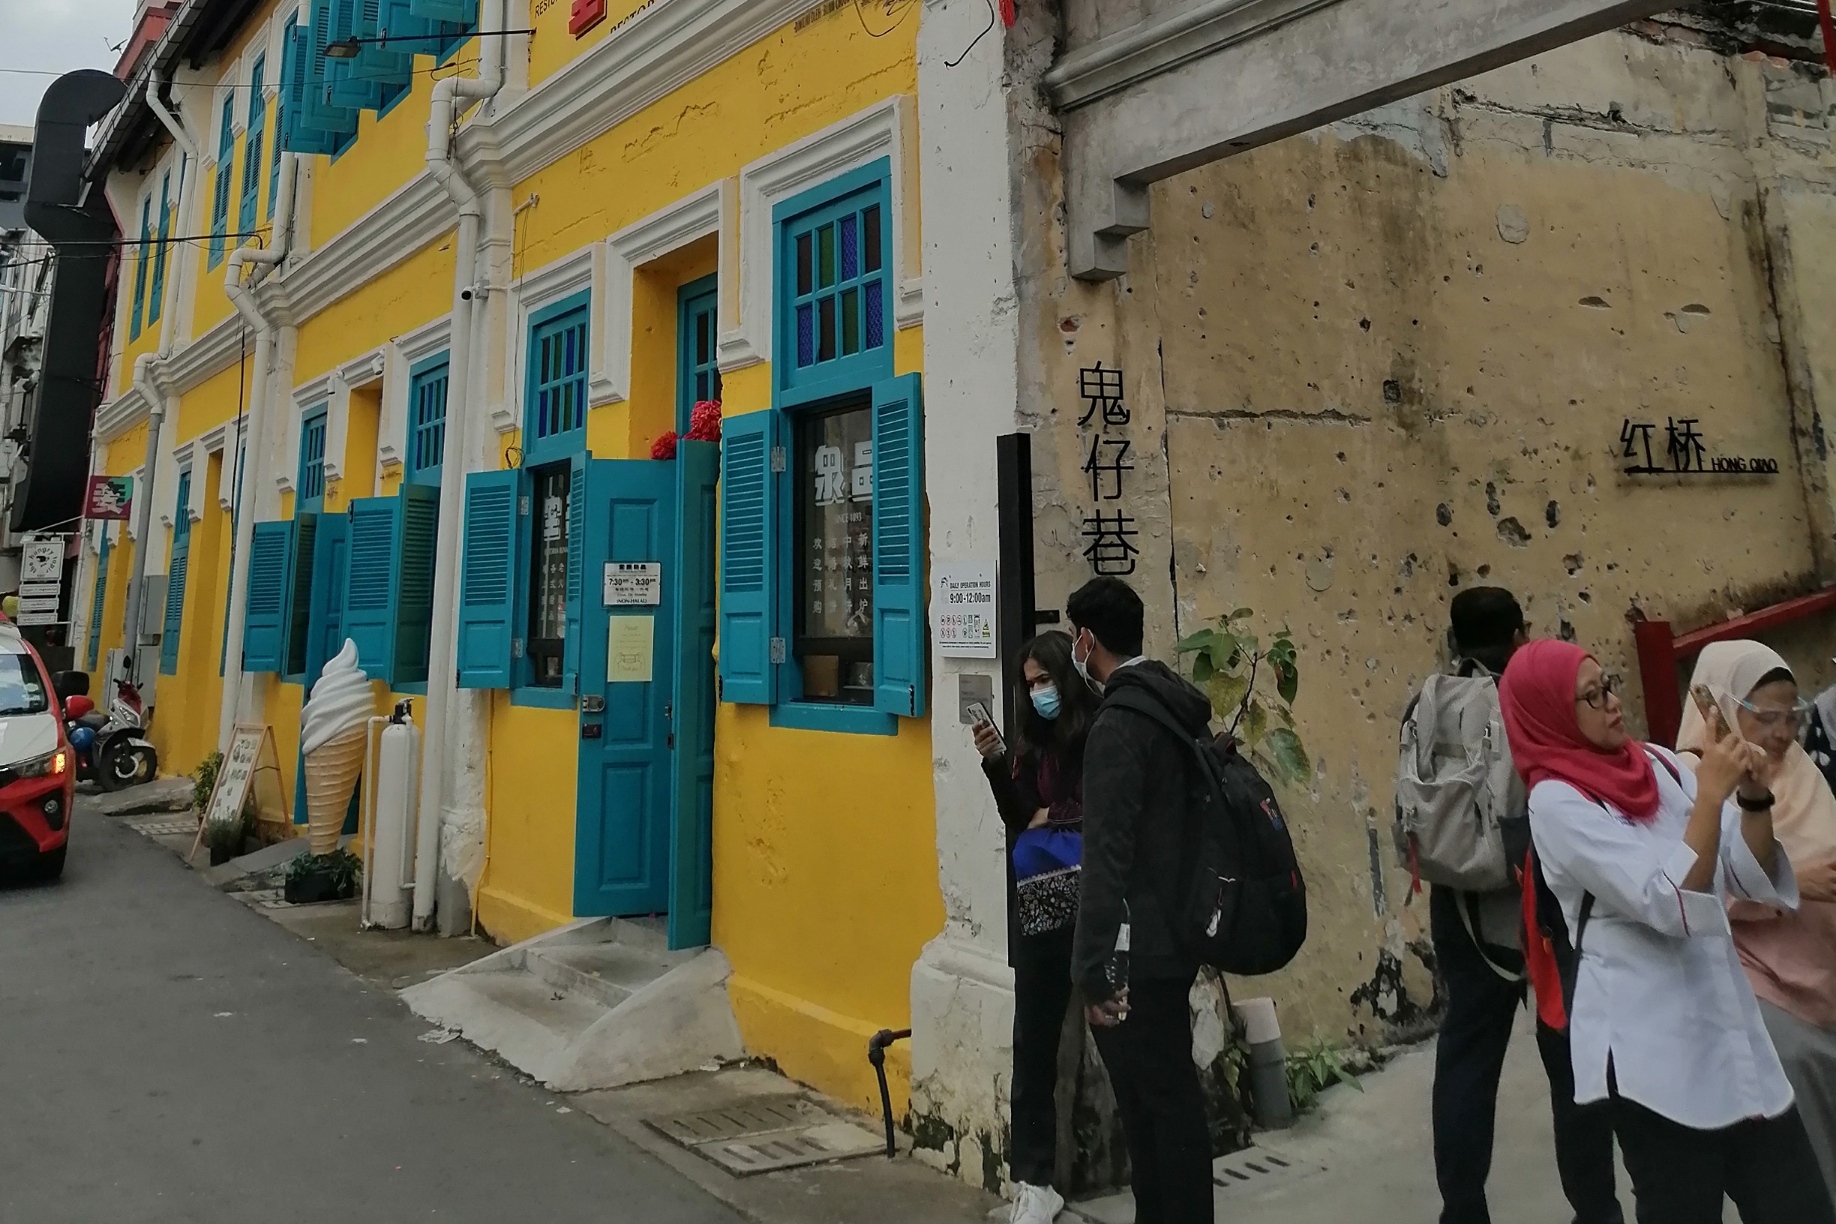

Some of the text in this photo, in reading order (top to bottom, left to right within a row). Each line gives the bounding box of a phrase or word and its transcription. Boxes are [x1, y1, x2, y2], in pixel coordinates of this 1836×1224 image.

[1077, 360, 1140, 576] 鬼仔巷
[1620, 416, 1706, 474] 红桥
[1711, 457, 1746, 472] HONG
